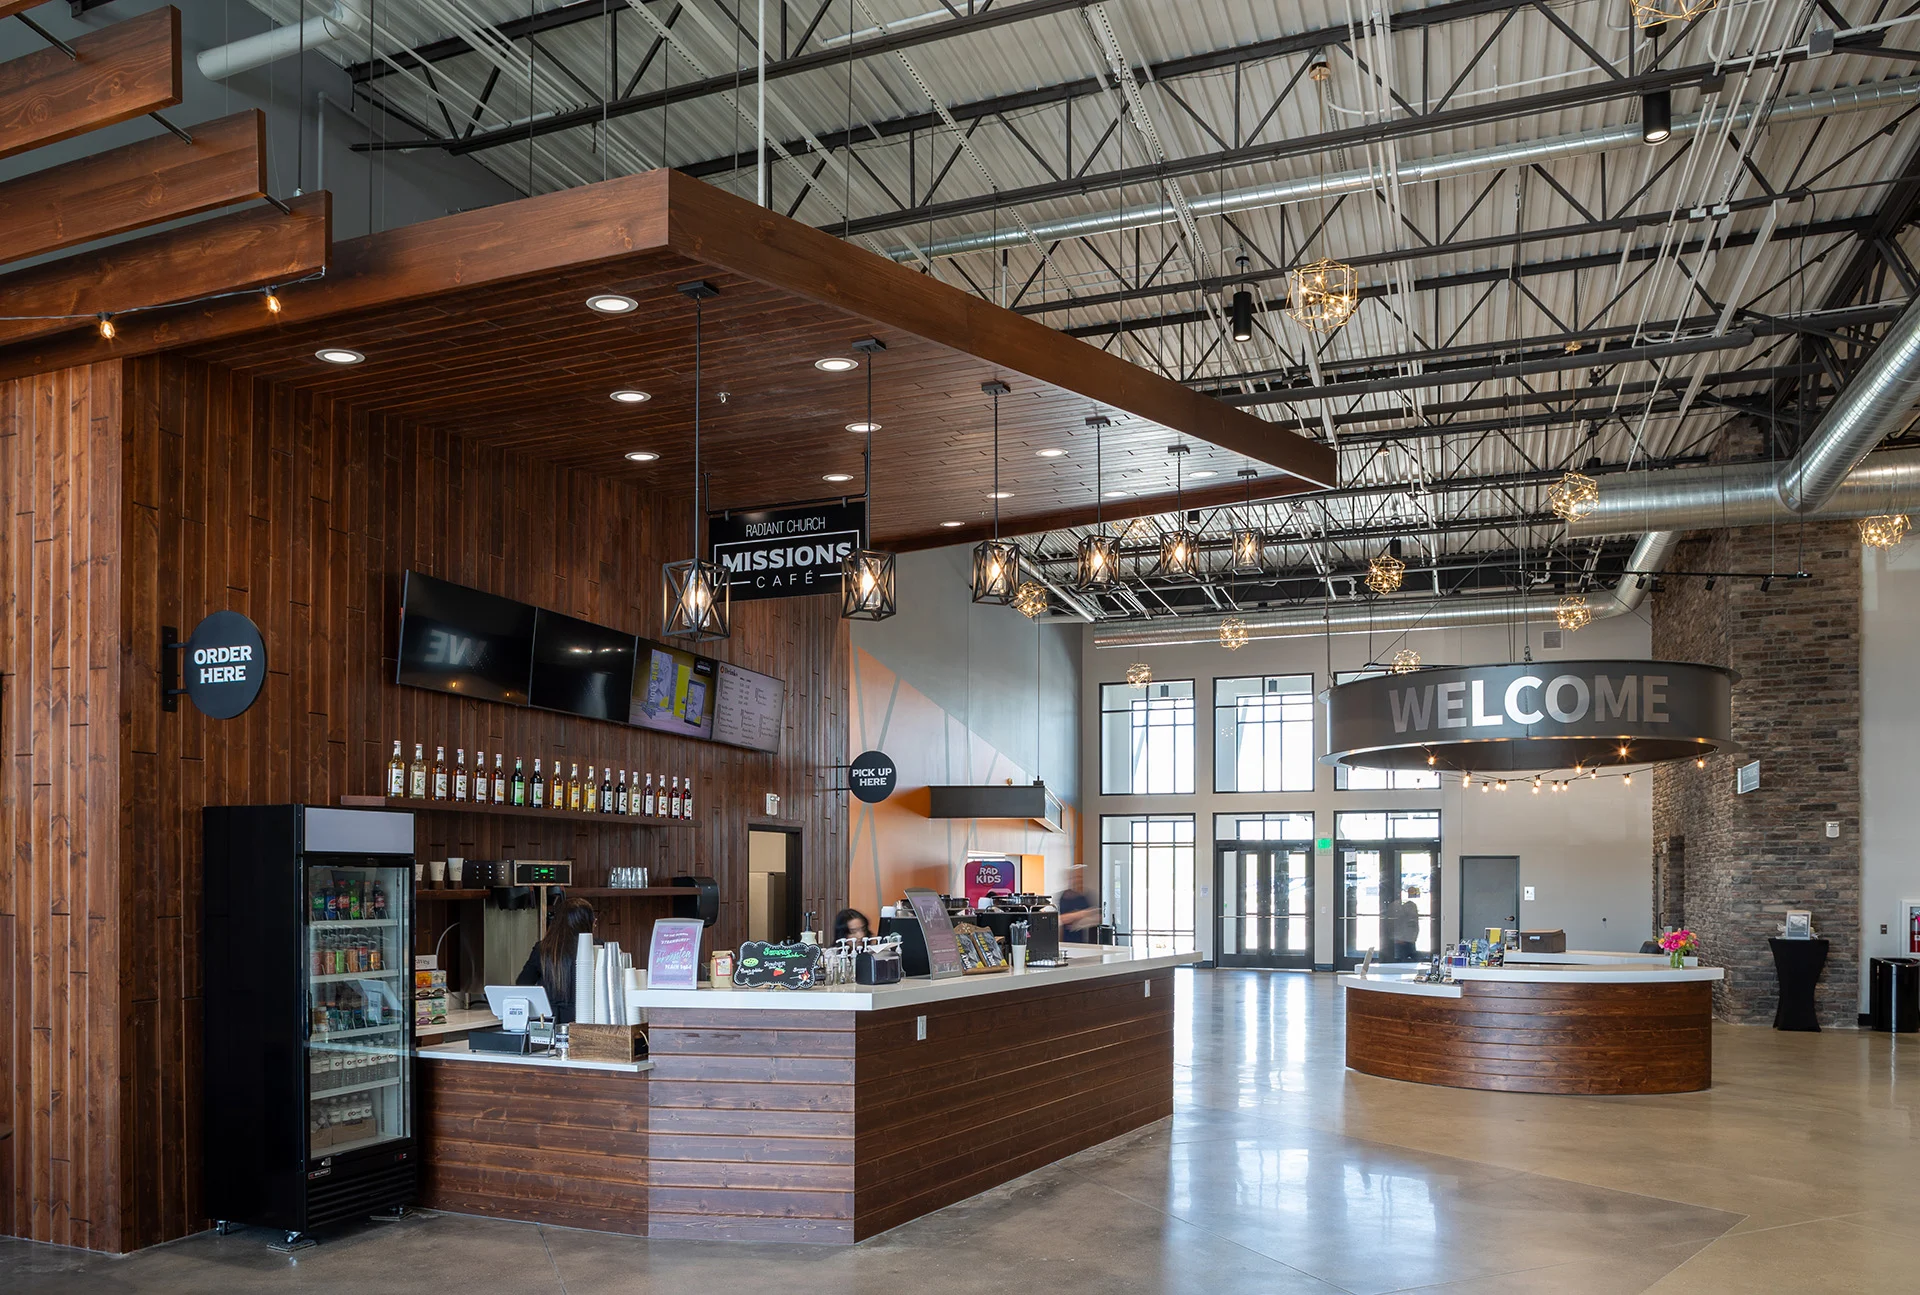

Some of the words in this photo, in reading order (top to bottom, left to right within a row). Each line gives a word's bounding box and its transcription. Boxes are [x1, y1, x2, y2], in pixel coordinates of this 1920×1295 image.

[745, 520, 785, 538] RADIANT
[786, 516, 826, 533] CHURCH
[721, 542, 852, 573] MISSIONS
[756, 569, 814, 589] CAFÉ
[194, 645, 253, 665] ORDER
[199, 665, 247, 684] HERE
[1388, 674, 1670, 733] WELCOME
[852, 768, 876, 778] PICK
[877, 767, 893, 776] UP
[859, 777, 887, 787] HERE
[976, 875, 1002, 884] KIDS
[979, 867, 999, 876] RAD
